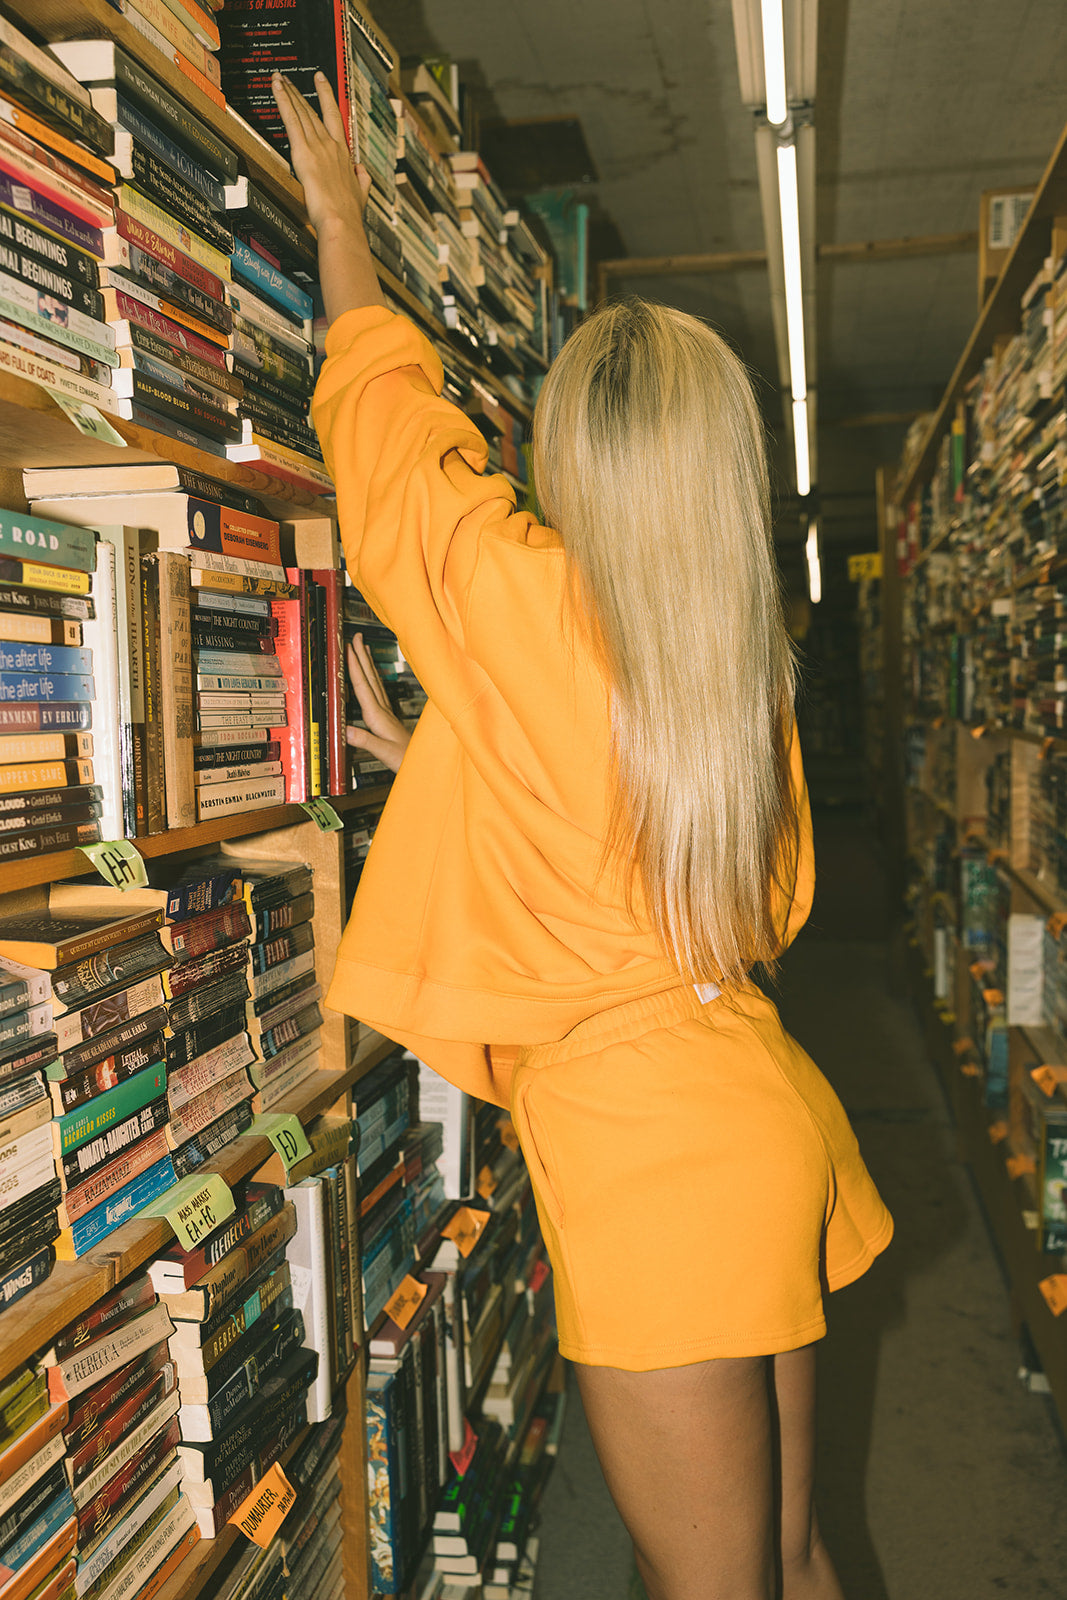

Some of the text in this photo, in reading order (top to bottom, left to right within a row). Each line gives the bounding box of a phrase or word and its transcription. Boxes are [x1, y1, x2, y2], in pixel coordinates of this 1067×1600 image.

[134, 75, 160, 104] WOMAN
[159, 98, 179, 121] INSIDE
[15, 221, 68, 267] BEGINNINGS
[127, 217, 145, 241] Jane
[21, 254, 73, 301] BEGINNINGS
[11, 353, 27, 373] FULL
[27, 359, 36, 375] OF
[36, 362, 56, 385] COATS
[136, 380, 173, 404] HALF-BLOOD
[172, 396, 190, 412] BLUES
[12, 525, 59, 552] ROAD
[126, 544, 137, 586] LION
[11, 592, 31, 606] KING
[129, 621, 141, 690] HEARTH
[205, 636, 236, 649] MISSING
[15, 648, 37, 668] after
[37, 647, 53, 673] life
[16, 678, 39, 698] after
[38, 676, 55, 702] life
[42, 710, 53, 724] EV
[133, 734, 142, 768] JOHN
[245, 788, 277, 802] BLACKWATER
[18, 837, 38, 852] KING
[39, 833, 57, 850] JOHN
[63, 1106, 117, 1149] BACHELOR KISSES
[276, 1128, 299, 1163] ED
[176, 1187, 213, 1224] MASS MARKET
[212, 1313, 246, 1358] REBECCA
[72, 1341, 121, 1382] REBECCA
